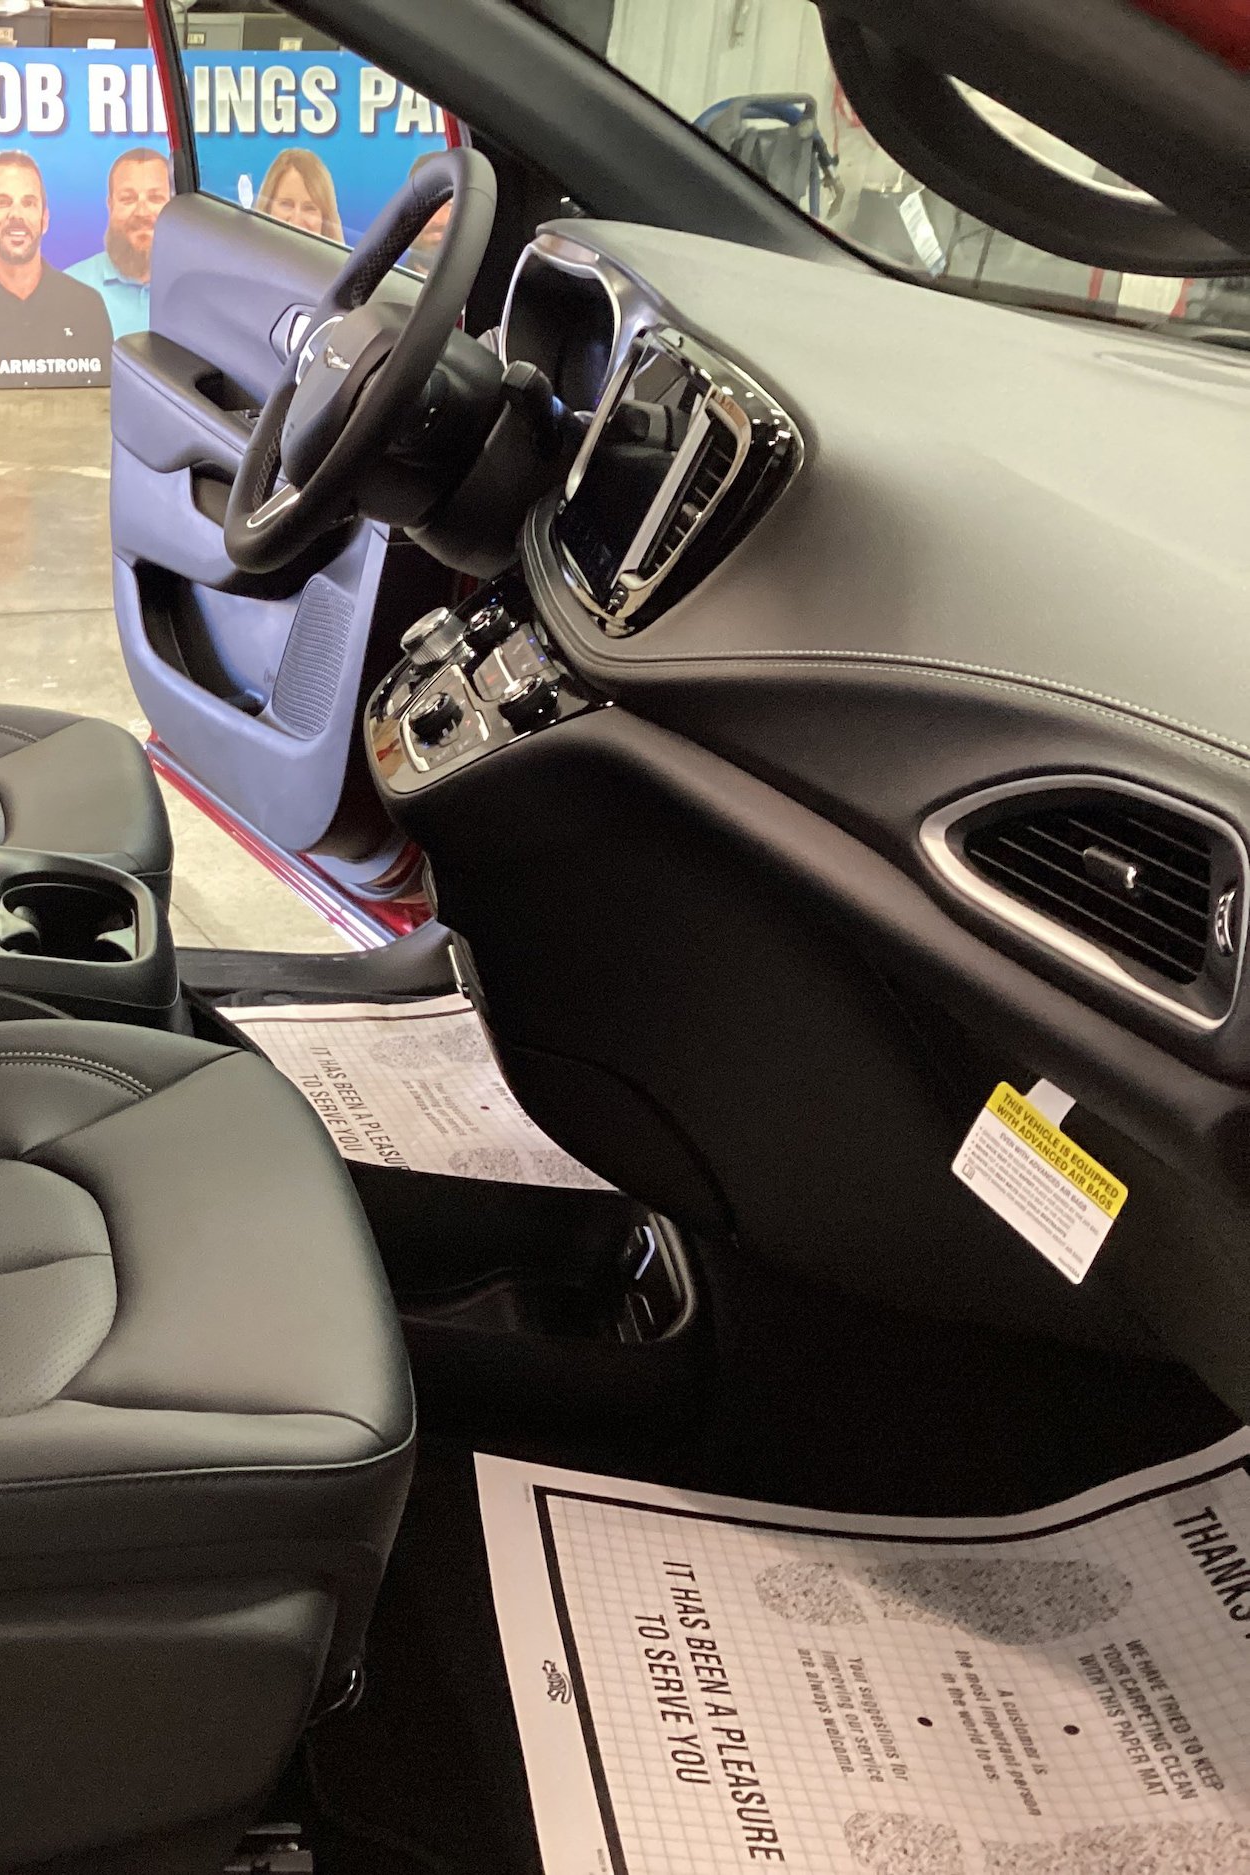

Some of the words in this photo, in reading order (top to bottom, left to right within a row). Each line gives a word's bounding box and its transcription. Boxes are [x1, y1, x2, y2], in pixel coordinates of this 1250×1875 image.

[88, 62, 337, 135] RIINGS
[359, 65, 446, 134] PA
[0, 357, 102, 374] ARMSTRONG
[309, 1046, 332, 1057] IT
[298, 1073, 323, 1088] TO
[317, 1059, 348, 1080] HAS
[309, 1091, 348, 1126] SERVE
[333, 1082, 368, 1111] BEEN
[352, 1113, 374, 1121] A
[334, 1128, 365, 1152] YOU
[996, 1104, 1019, 1128] WITH
[1018, 1124, 1069, 1171] ADVANCED
[1067, 1168, 1086, 1187] AIR
[1085, 1182, 1113, 1211] BAGS
[1003, 1093, 1024, 1115] THIS
[1023, 1111, 1061, 1149] VEHICLE
[1059, 1144, 1072, 1157] IS
[1070, 1152, 1119, 1199] EQUIPPED
[1028, 1159, 1061, 1189] ADVANCED
[1059, 1185, 1072, 1197] AIR
[662, 1560, 696, 1582] IT
[670, 1586, 711, 1631] HAS
[634, 1614, 670, 1640] TO
[685, 1636, 733, 1695] BEEN
[797, 1648, 816, 1669] are
[1125, 1638, 1149, 1660] WE
[644, 1647, 695, 1725] SERVE
[805, 1671, 832, 1715] always
[941, 1672, 957, 1684] in
[1135, 1659, 1170, 1692] HAVE
[704, 1701, 738, 1718] A
[947, 1687, 967, 1707] the
[997, 1689, 1015, 1698] A
[847, 1657, 868, 1684] Your
[859, 1686, 900, 1760] suggestions
[890, 1762, 909, 1782] for
[958, 1710, 988, 1746] world
[1002, 1701, 1042, 1761] customer
[1078, 1653, 1108, 1686] WITH
[1096, 1687, 1125, 1719] THIS
[1113, 1719, 1151, 1765] PAPER
[1137, 1767, 1169, 1796] MAT
[1100, 1642, 1131, 1678] YOUR
[1119, 1677, 1172, 1752] CARPETING
[1160, 1754, 1199, 1800] CLEAN
[1156, 1693, 1192, 1735] TRIED
[845, 1713, 864, 1734] our
[855, 1736, 885, 1784] service
[954, 1650, 974, 1669] the
[965, 1672, 991, 1702] most
[979, 1705, 1022, 1768] important
[1005, 1768, 1042, 1817] person
[1180, 1735, 1204, 1756] TO
[667, 1734, 712, 1786] YOU
[975, 1748, 991, 1761] to
[1031, 1762, 1048, 1776] is
[1191, 1757, 1225, 1792] KEEP
[712, 1726, 786, 1863] PLEASURE
